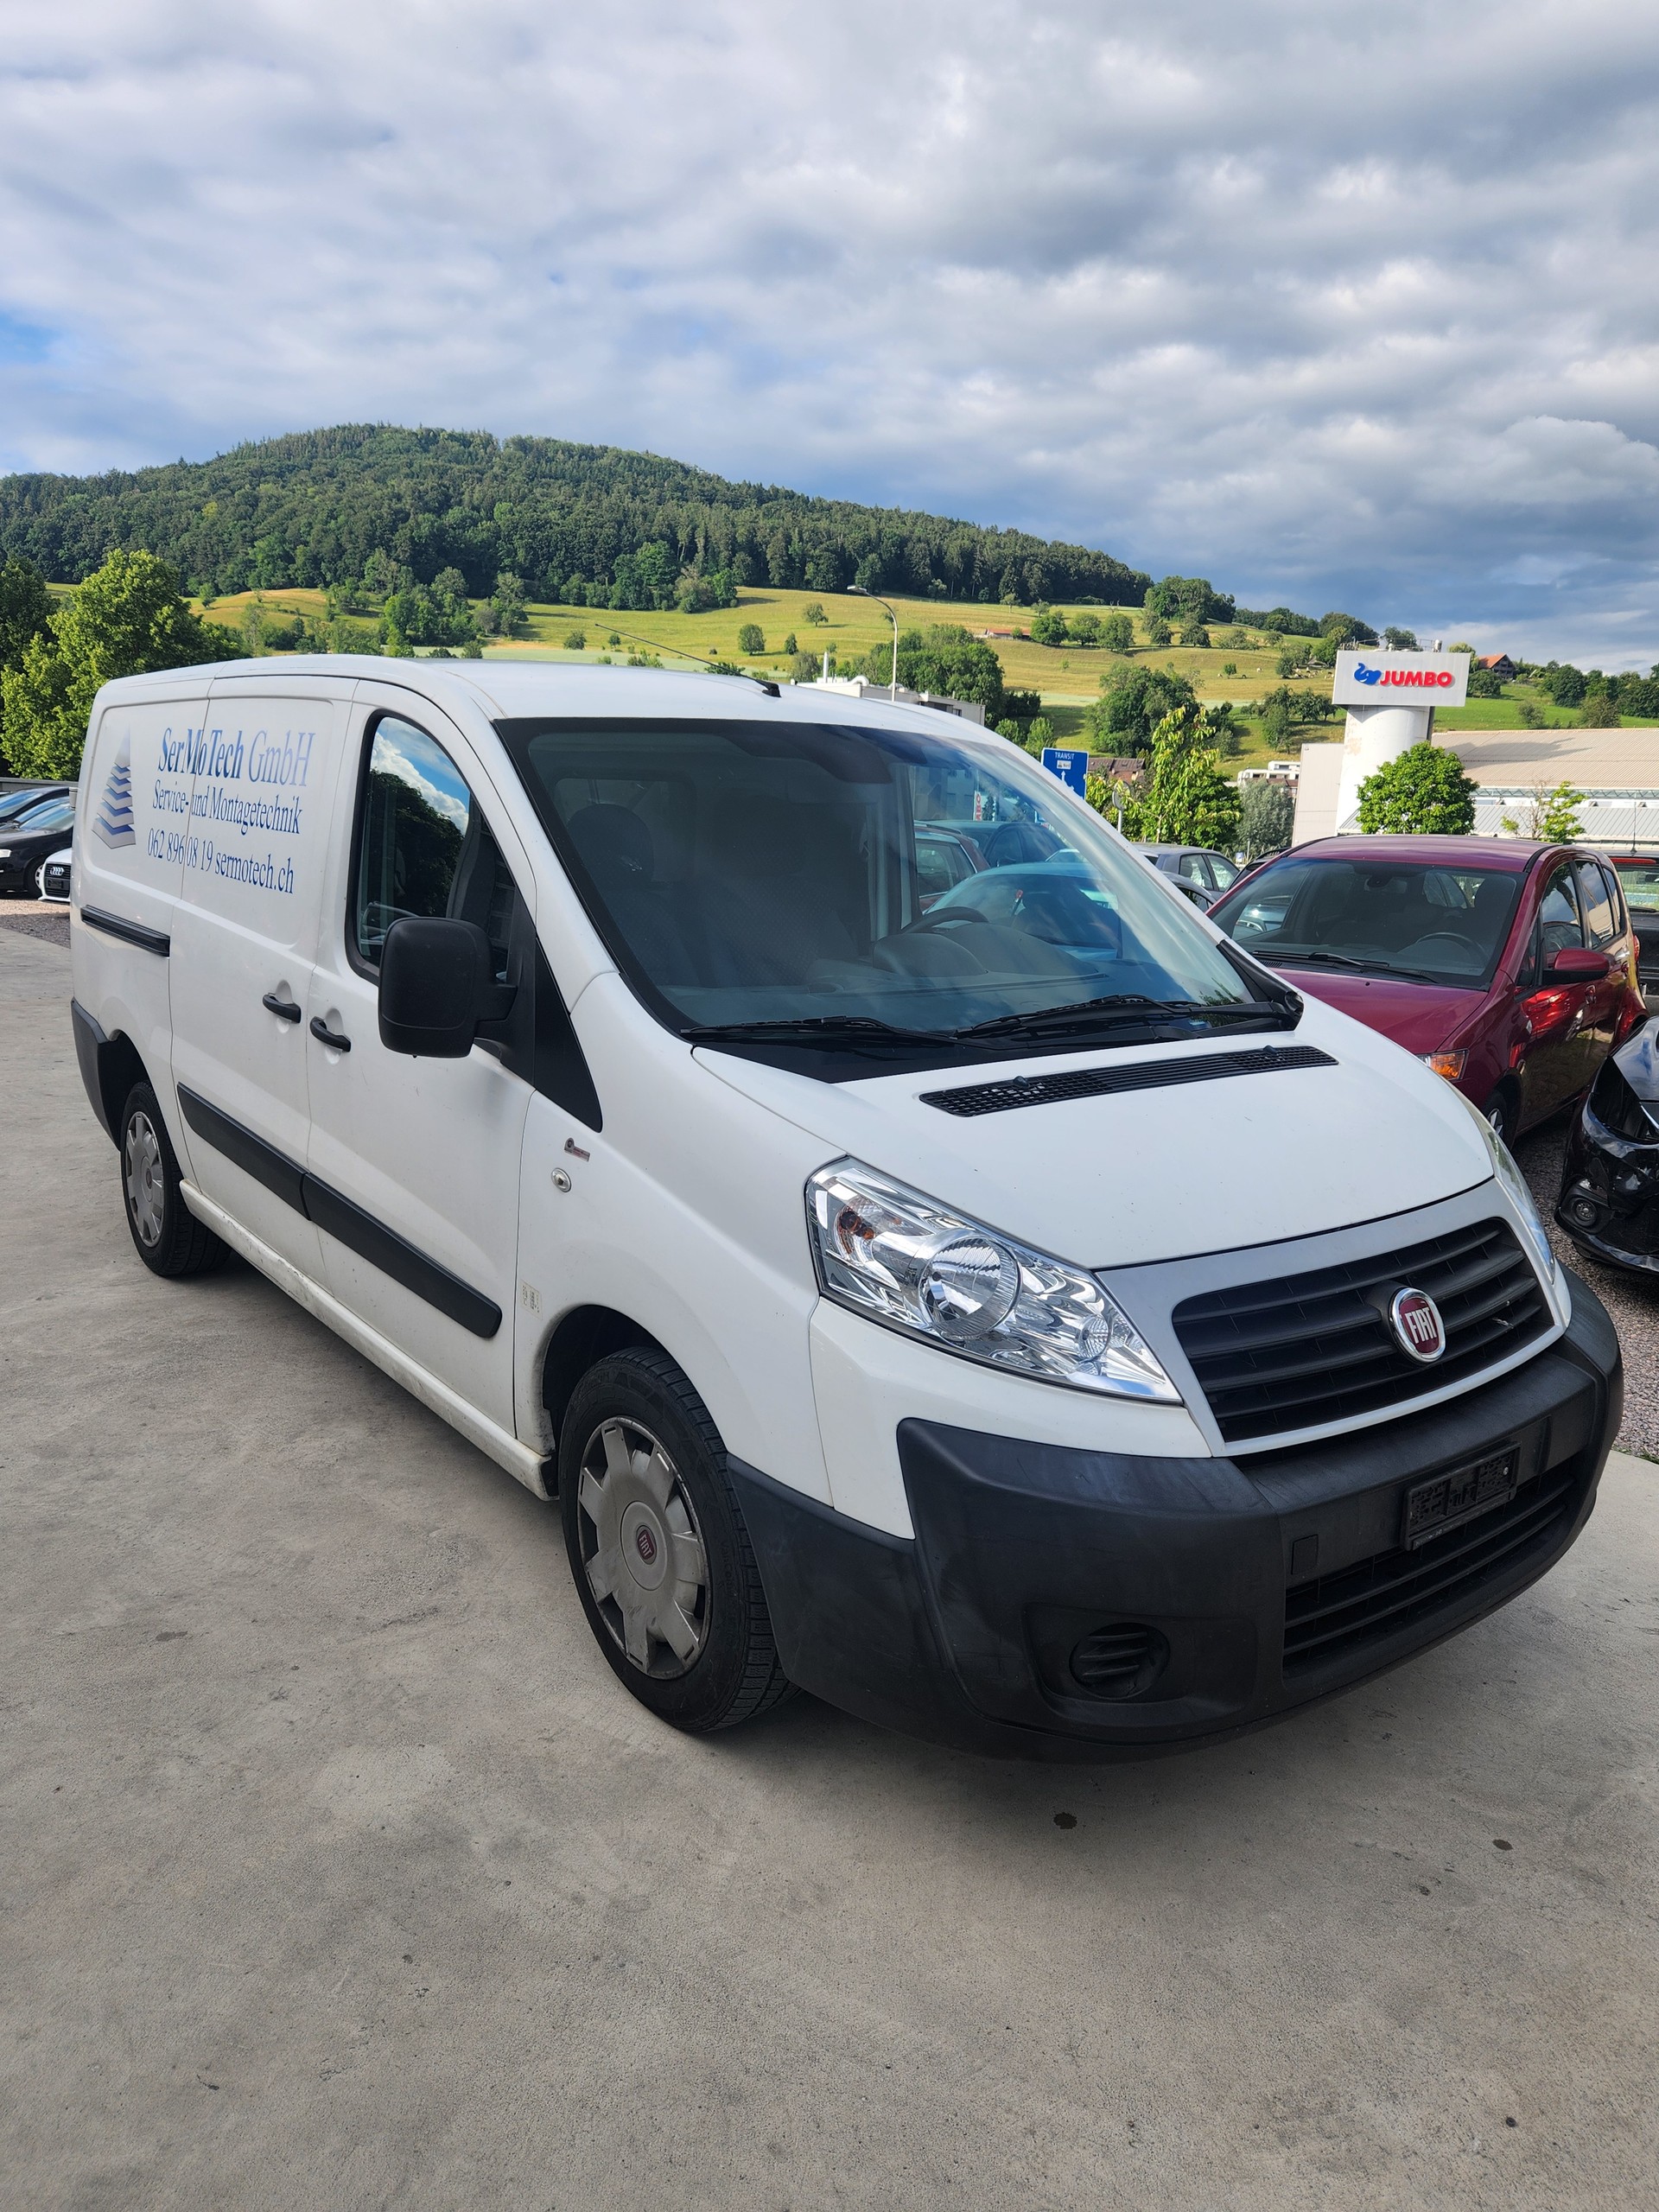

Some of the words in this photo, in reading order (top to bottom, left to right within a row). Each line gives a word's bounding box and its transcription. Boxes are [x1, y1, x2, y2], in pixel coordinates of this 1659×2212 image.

[1379, 670, 1453, 688] JUMBO
[249, 729, 315, 786] GmbH
[152, 779, 189, 813] Service-
[191, 785, 210, 817] und
[208, 786, 302, 836] Montagetechnik
[148, 828, 164, 859] 062
[167, 832, 186, 864] 896
[187, 836, 199, 868] 08
[200, 839, 213, 871] 19
[214, 851, 294, 894] sermotech.ch
[1405, 1306, 1437, 1344] FIAT
[639, 1534, 652, 1556] FIAT
